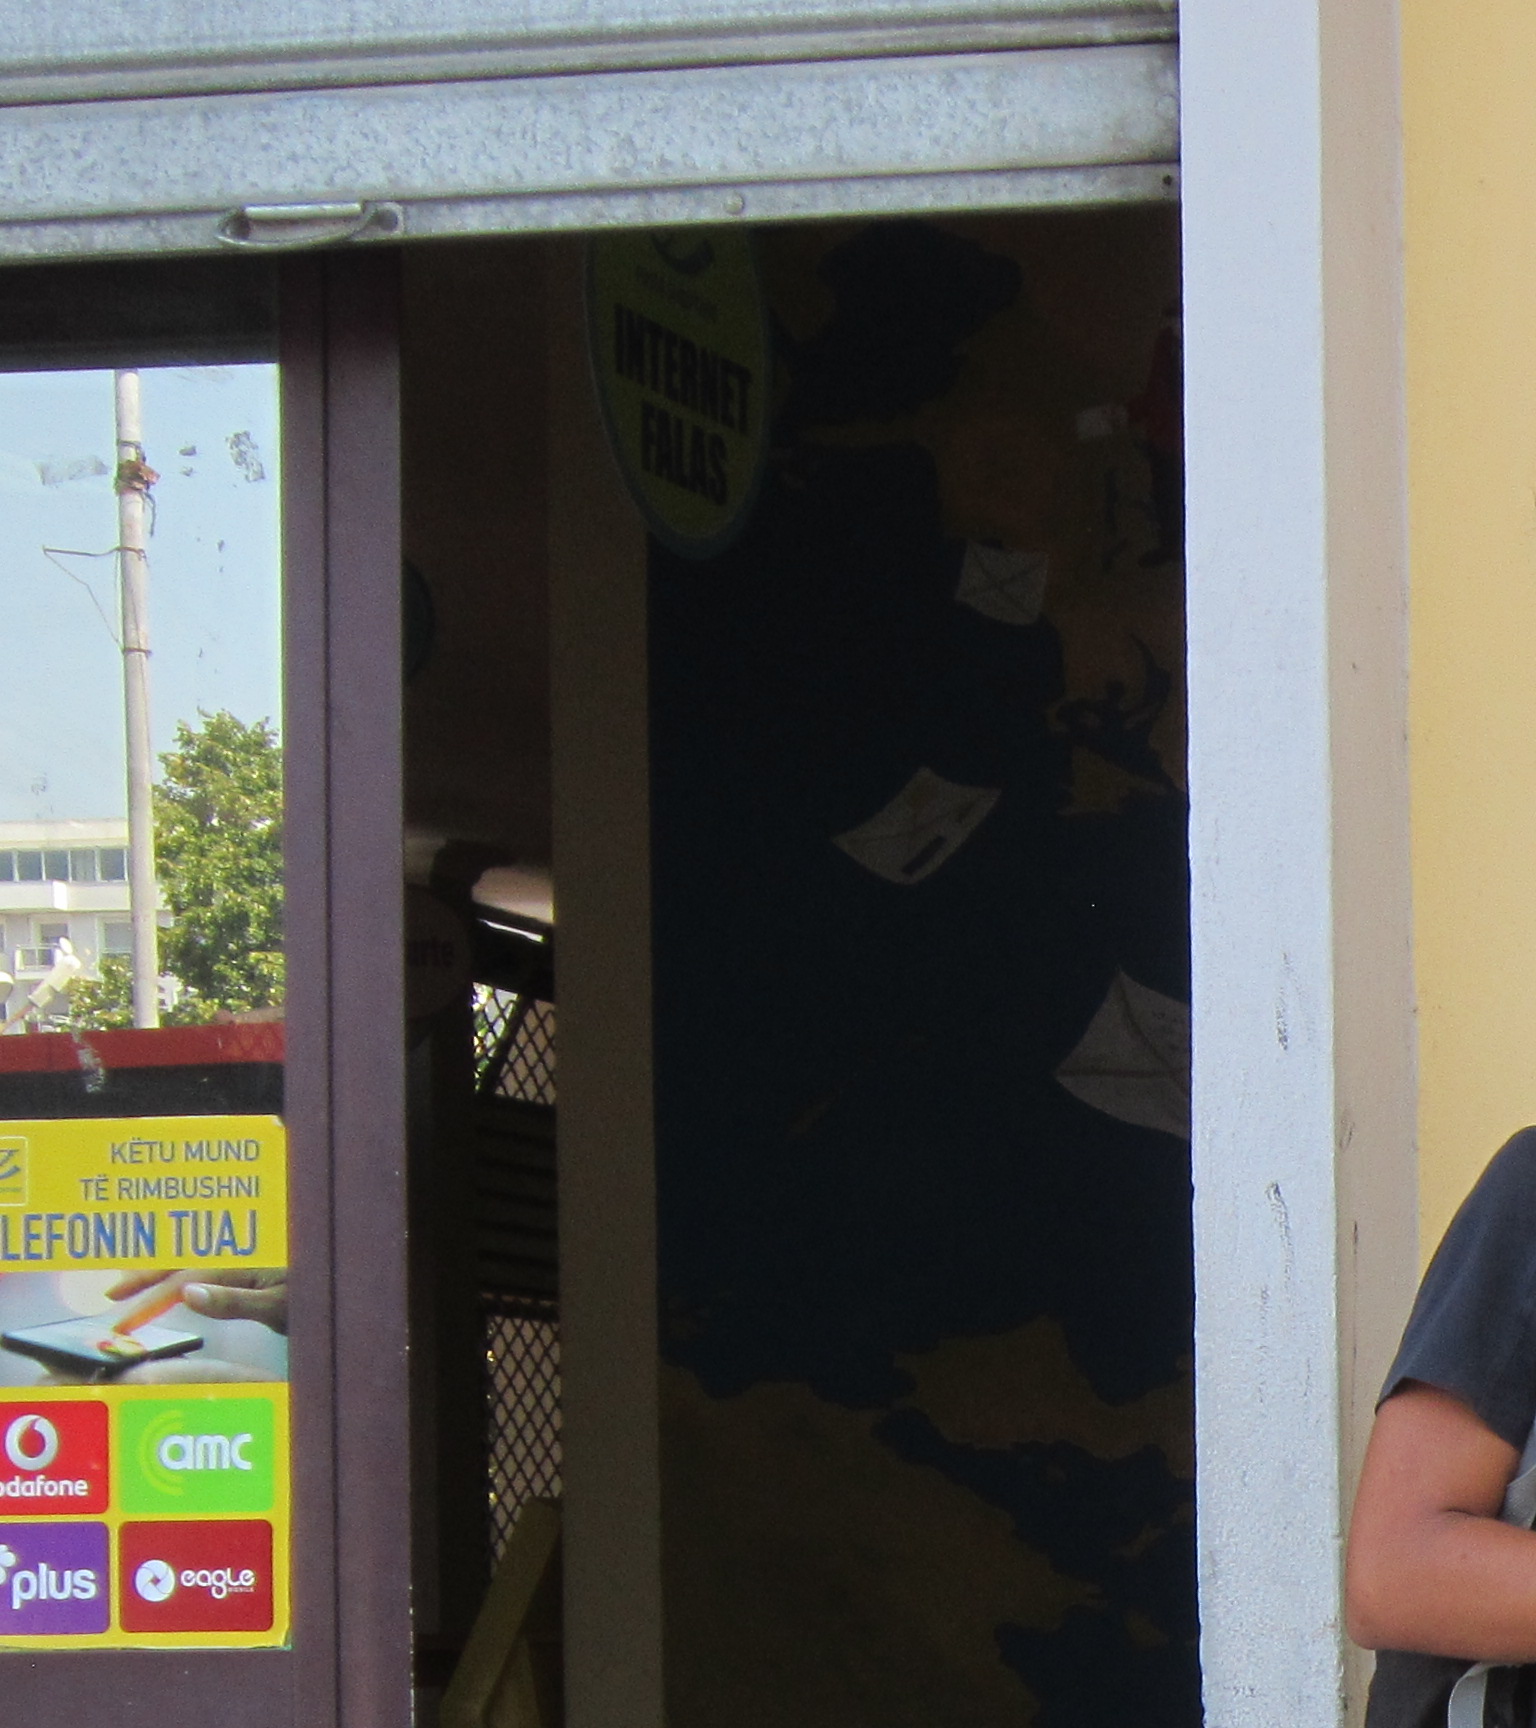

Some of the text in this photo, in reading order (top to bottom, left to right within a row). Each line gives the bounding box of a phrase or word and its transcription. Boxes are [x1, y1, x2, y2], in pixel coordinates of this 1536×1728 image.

[614, 303, 752, 436] INTERNET
[640, 398, 729, 507] FALAS
[110, 1137, 260, 1165] KËTU MUND
[79, 1174, 260, 1202] TË RIMBUSHNI
[168, 1209, 258, 1258] TUAJ
[158, 1433, 253, 1471] amc
[12, 1562, 98, 1610] plus
